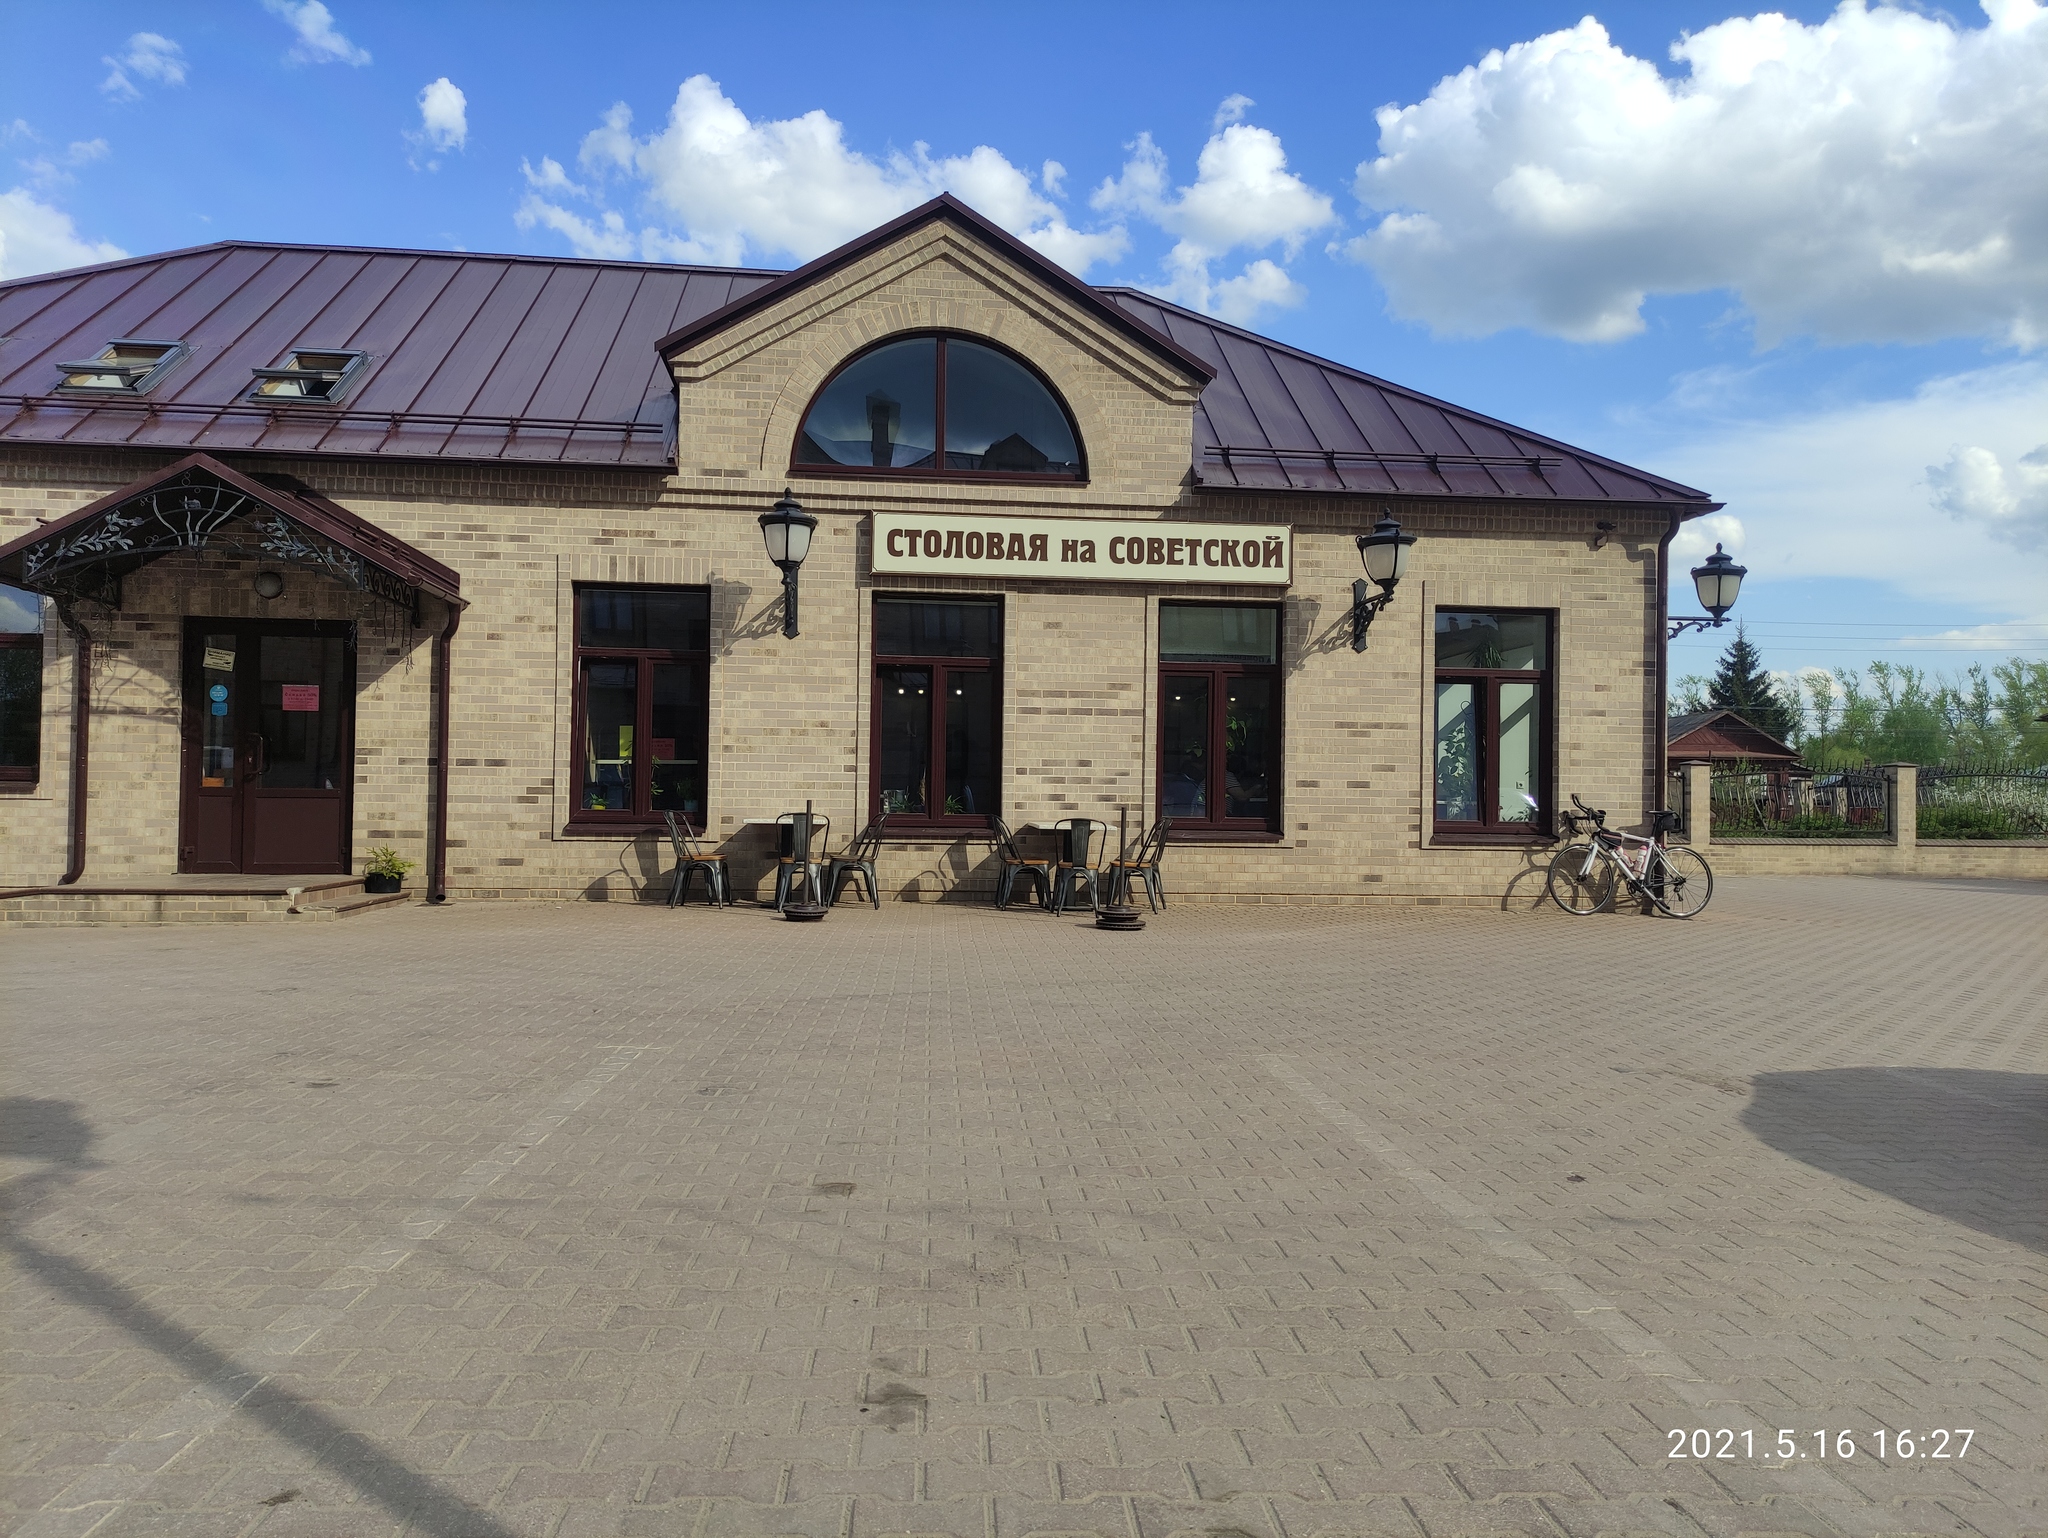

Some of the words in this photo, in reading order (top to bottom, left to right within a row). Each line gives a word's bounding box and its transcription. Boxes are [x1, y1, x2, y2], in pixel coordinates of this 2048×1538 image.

[886, 528, 1049, 562] СТОЛОВАЯ
[1061, 538, 1097, 563] на
[1109, 535, 1284, 568] СОВЕТСКОЙ
